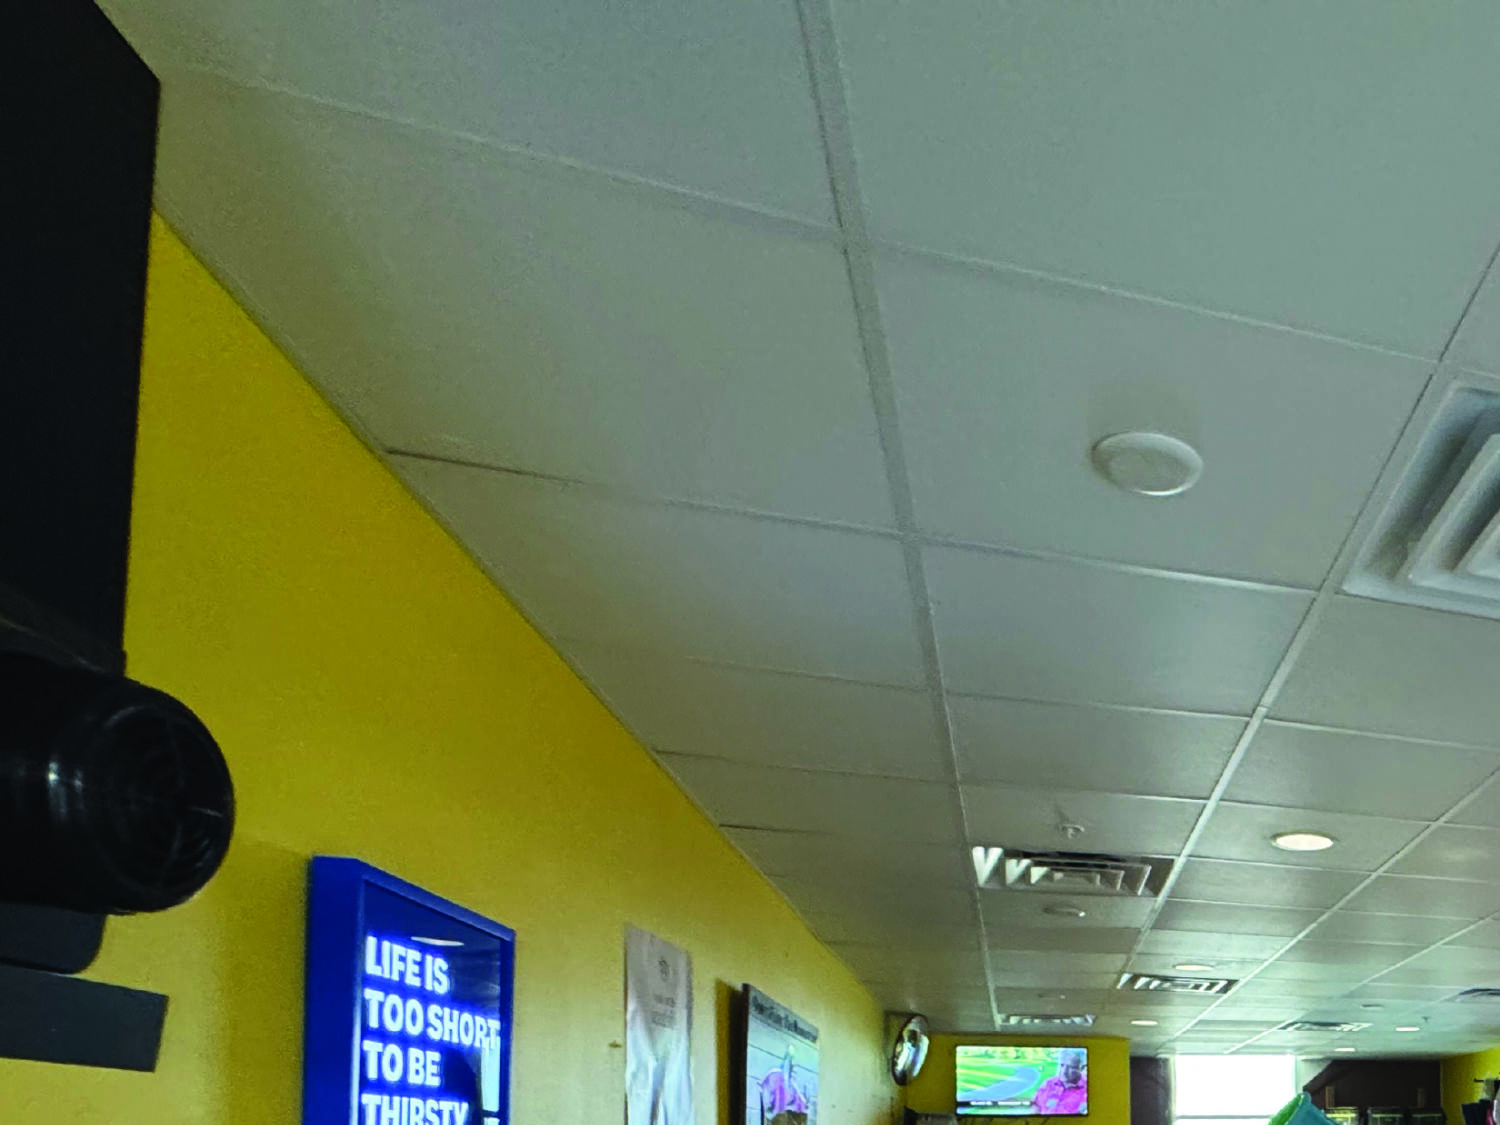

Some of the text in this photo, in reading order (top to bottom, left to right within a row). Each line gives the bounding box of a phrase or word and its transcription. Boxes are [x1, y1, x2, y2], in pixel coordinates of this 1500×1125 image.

[365, 936, 450, 995] LIFE IS
[363, 987, 501, 1050] TOO SHORT
[362, 1040, 442, 1088] TO BE
